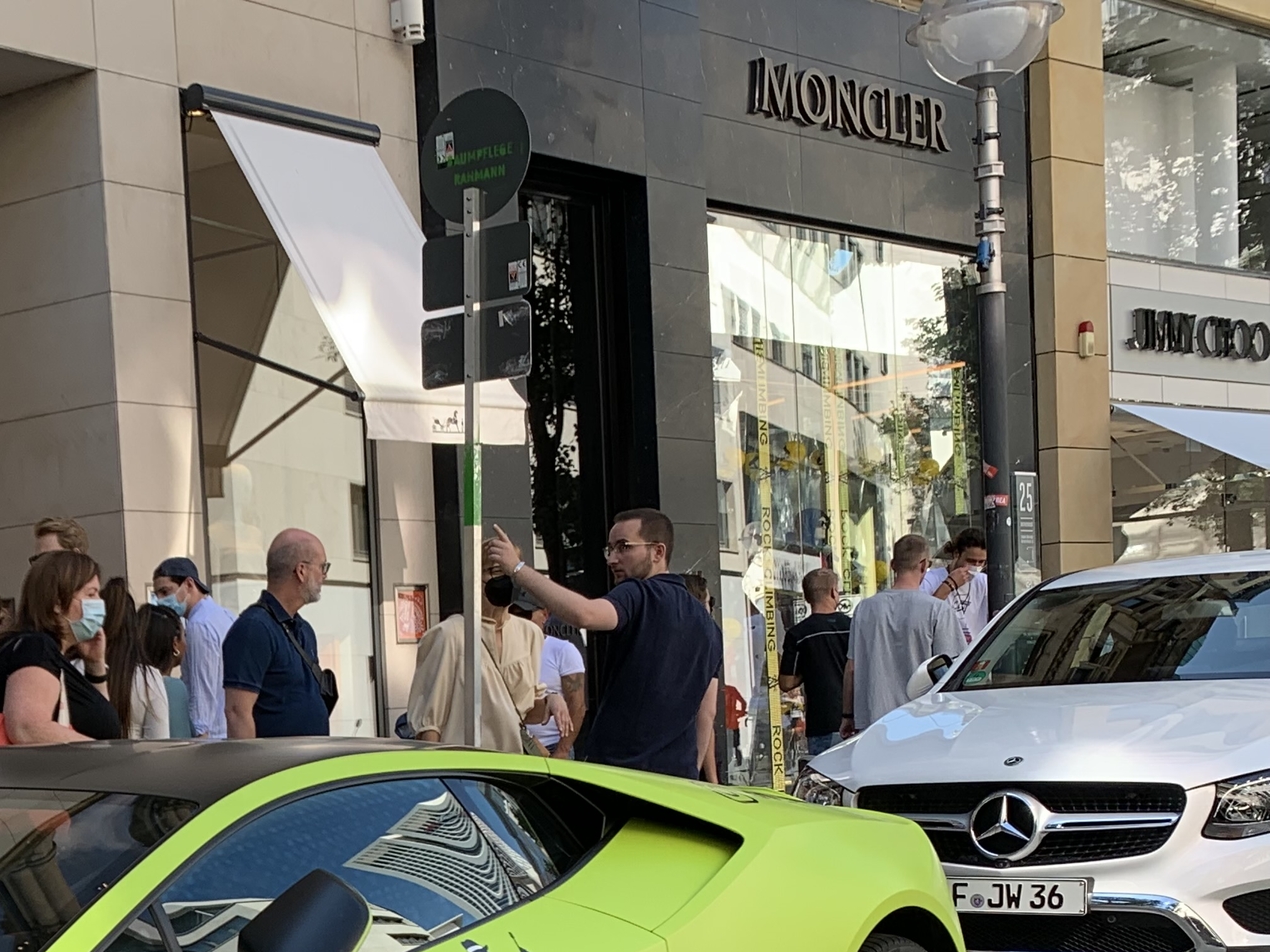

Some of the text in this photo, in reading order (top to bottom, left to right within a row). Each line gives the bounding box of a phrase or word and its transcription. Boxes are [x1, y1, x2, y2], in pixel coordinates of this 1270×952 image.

[747, 57, 952, 153] MONCLER
[1019, 481, 1034, 513] 25
[772, 725, 784, 775] ROCK
[952, 882, 1064, 910] F JW 36
